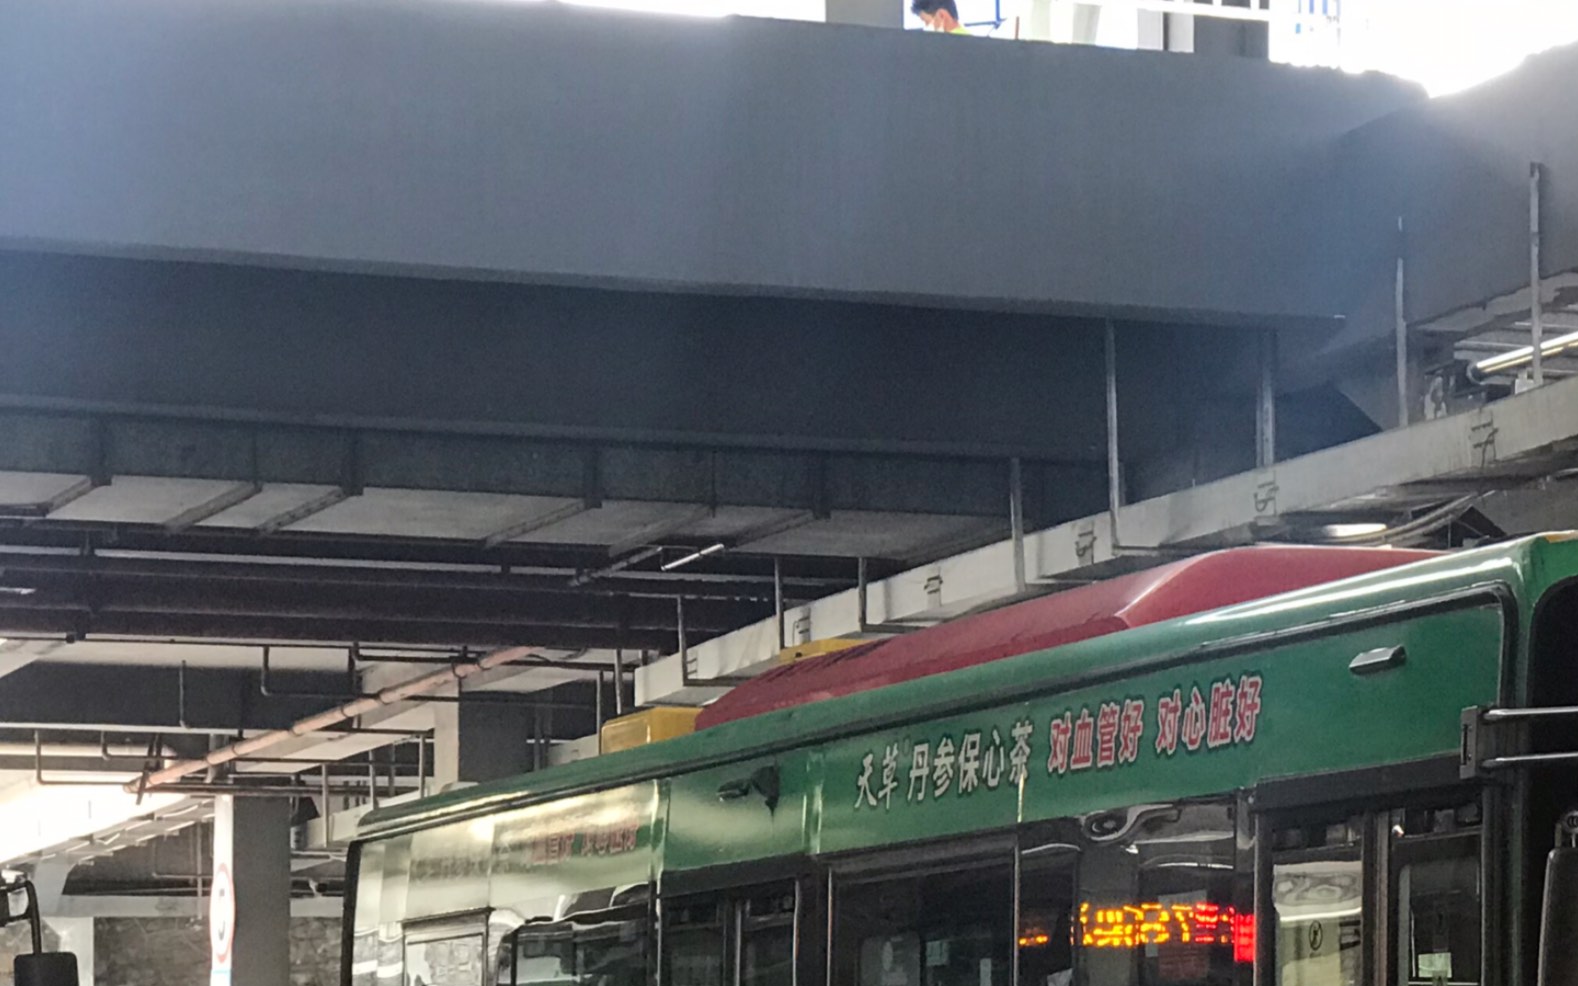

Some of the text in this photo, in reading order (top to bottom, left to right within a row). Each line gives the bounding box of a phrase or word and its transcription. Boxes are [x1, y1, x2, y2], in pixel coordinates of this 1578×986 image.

[1046, 699, 1144, 774] 对血管好
[1154, 675, 1263, 755] 对心脏好
